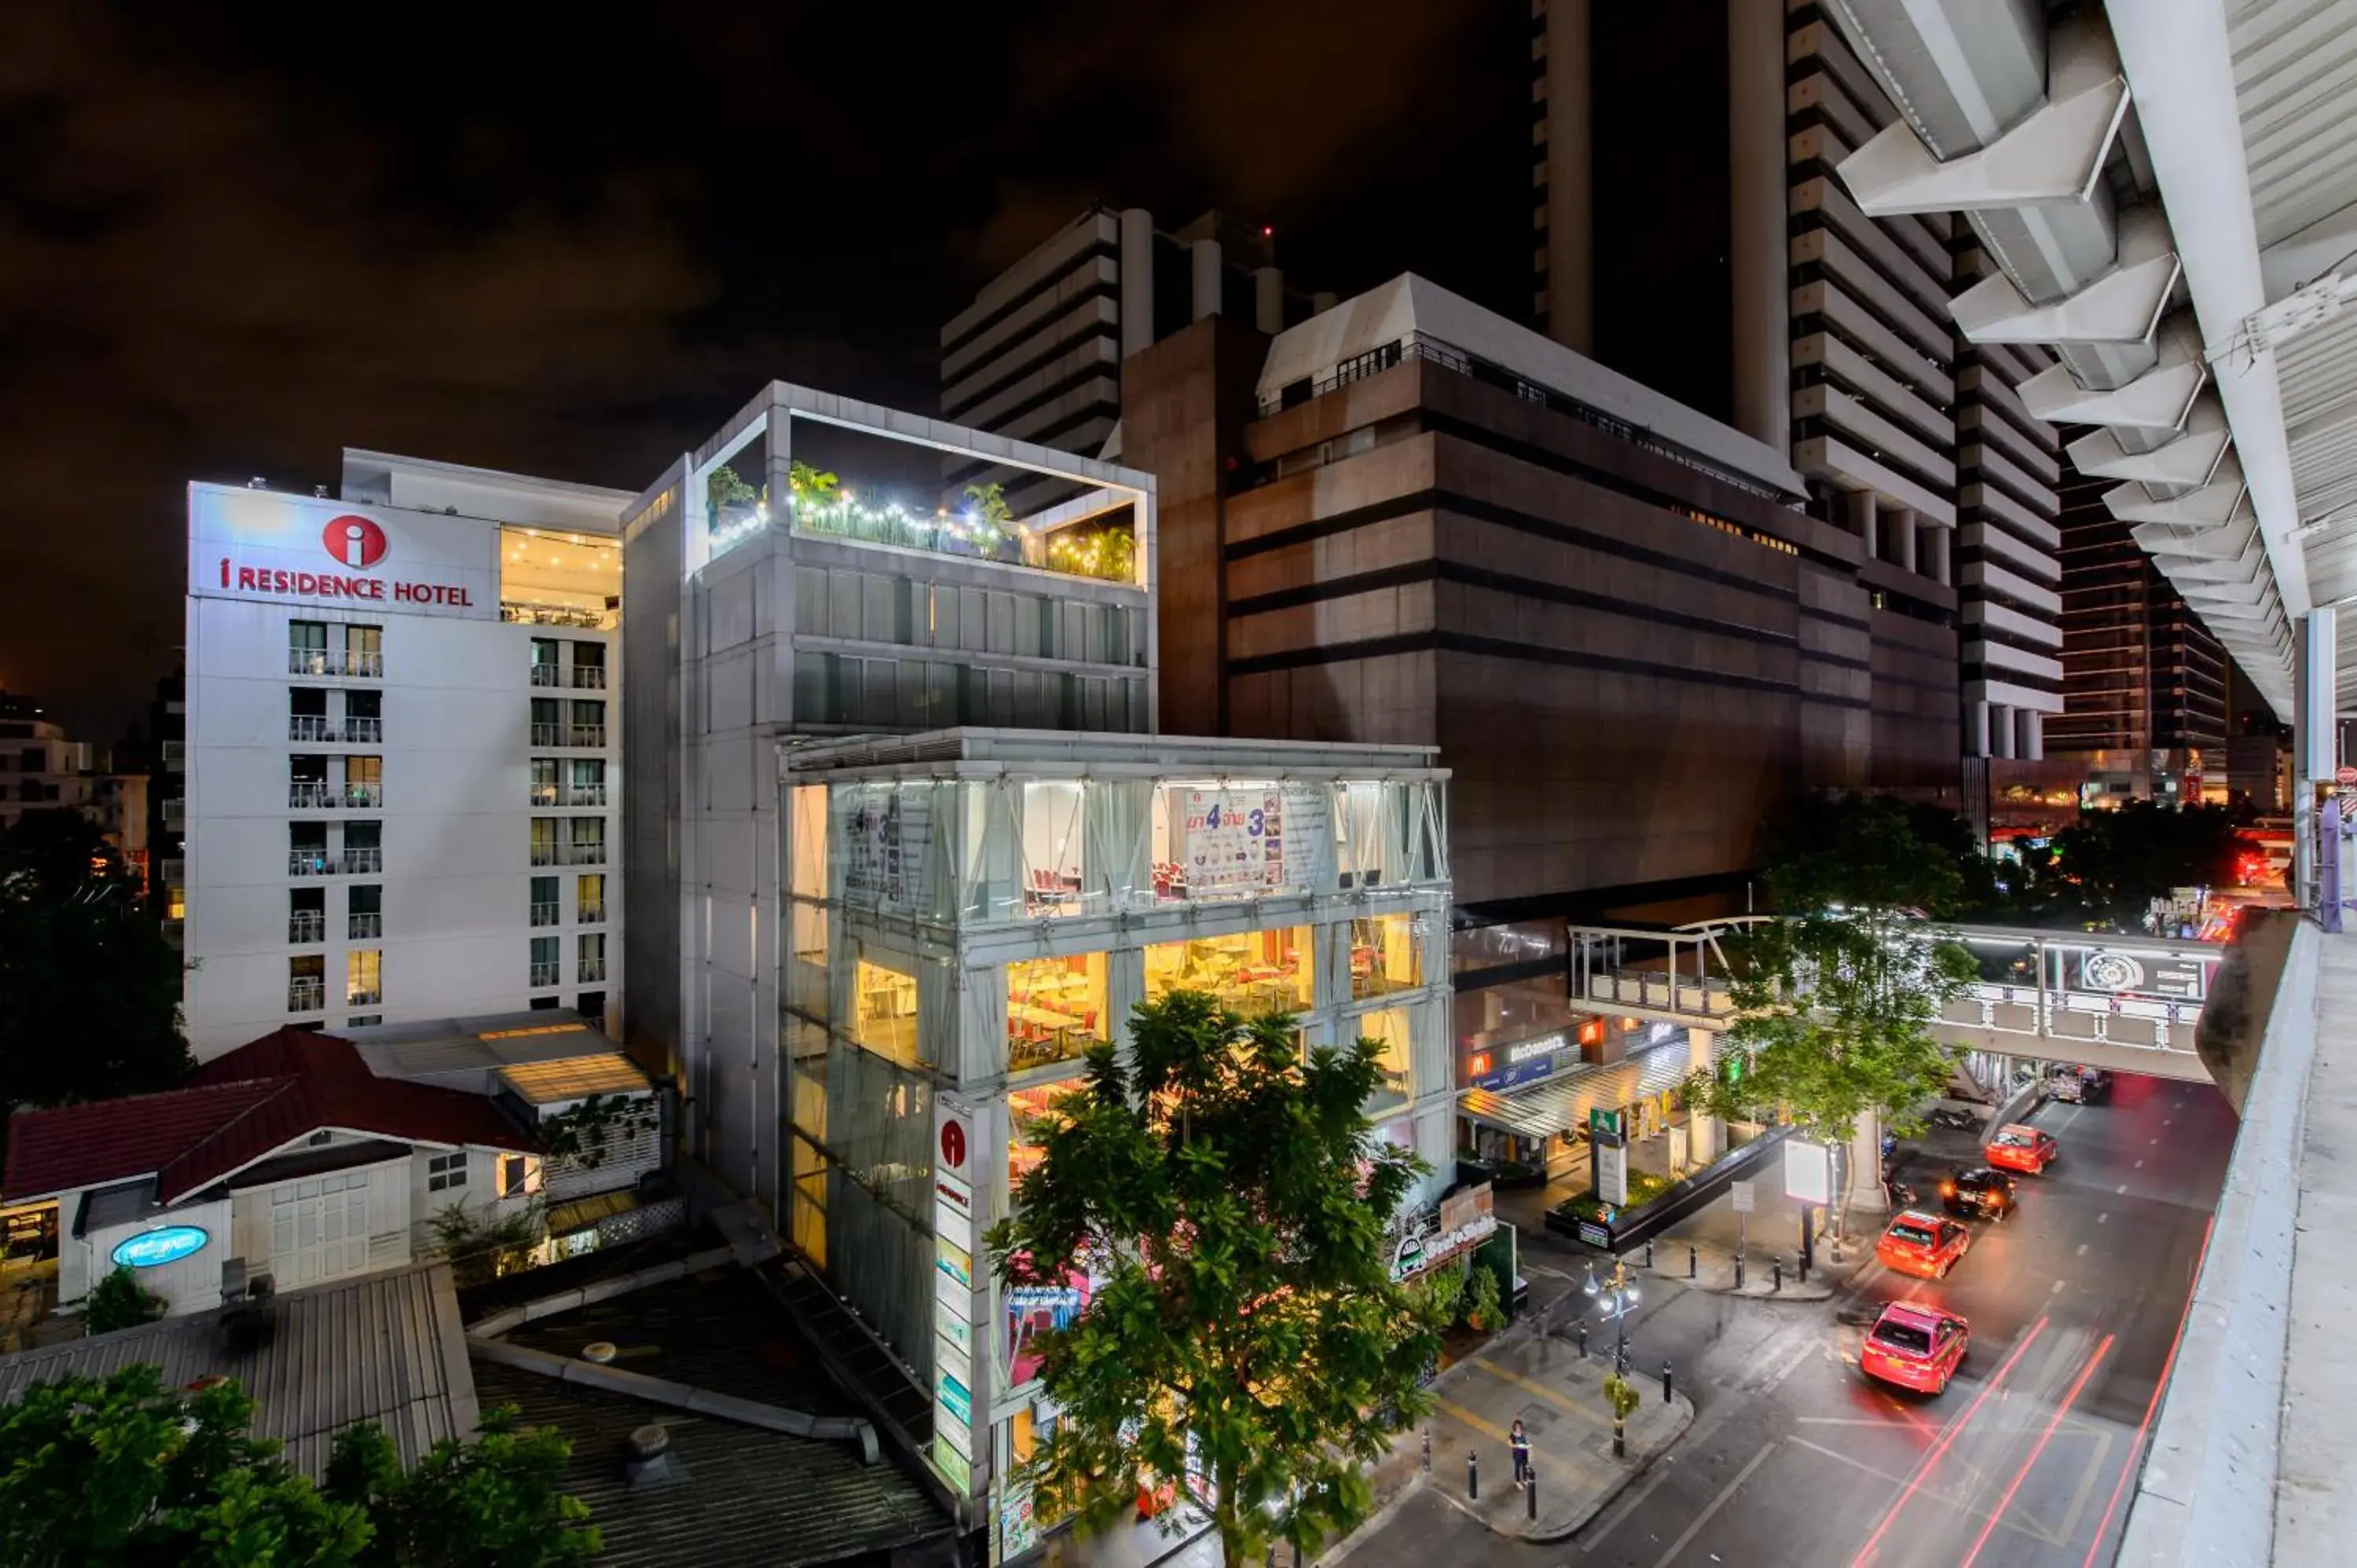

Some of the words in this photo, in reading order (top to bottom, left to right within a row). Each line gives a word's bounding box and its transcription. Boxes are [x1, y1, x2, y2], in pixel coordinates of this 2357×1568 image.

[239, 566, 383, 600] RESIDENCE
[394, 581, 474, 606] HOTEL
[878, 814, 889, 844] 3
[1206, 804, 1221, 830] 4
[1247, 808, 1264, 837] 3
